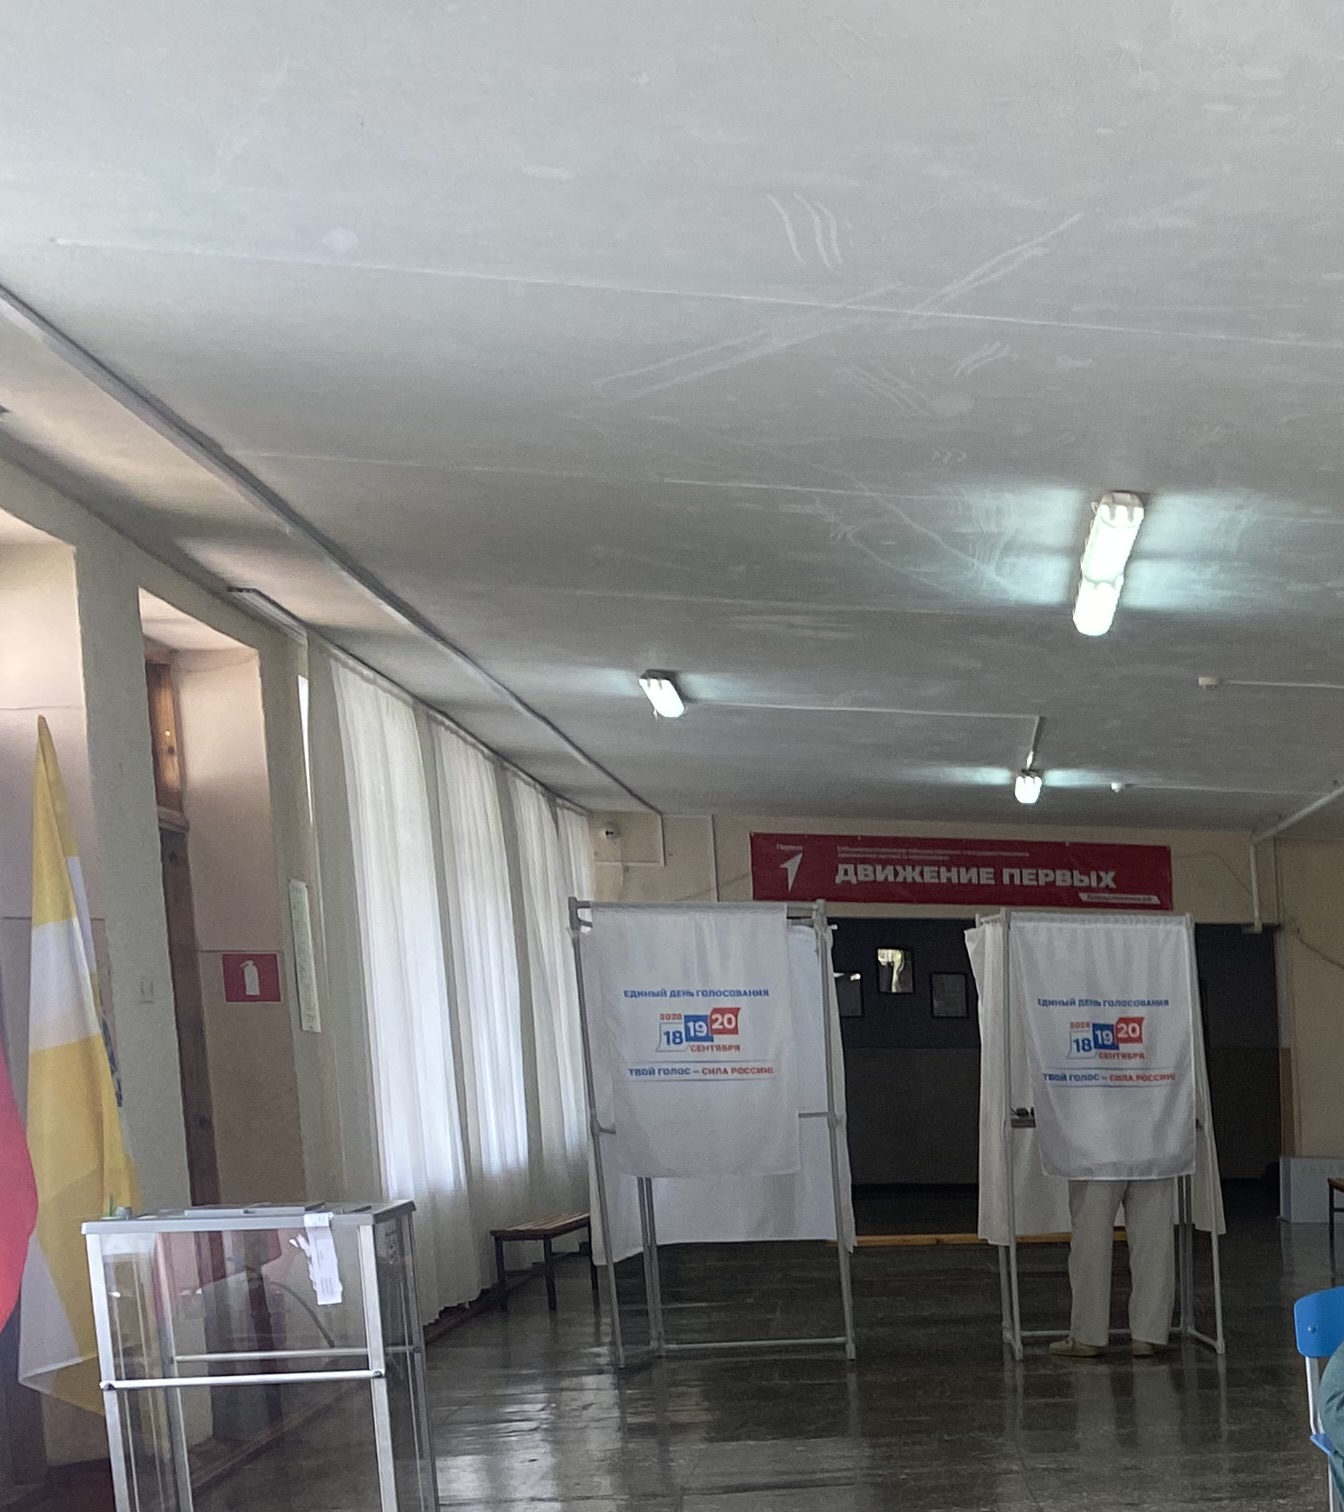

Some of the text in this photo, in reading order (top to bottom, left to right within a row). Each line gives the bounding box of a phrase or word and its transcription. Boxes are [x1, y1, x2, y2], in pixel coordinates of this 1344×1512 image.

[835, 863, 1117, 889] ДВИЖЕНИЕ ПЕРВЫХ
[624, 988, 769, 999] ЕДИНЫЙ ДЕНЬ ГОЛОСОВАНИЯ
[1103, 999, 1169, 1007] ГОЛОСОВАНИЯ
[664, 1013, 736, 1046] 18 19 20
[1073, 1023, 1140, 1053] 18 19 20
[690, 1044, 741, 1053] СЕНТЯБРЯ
[629, 1067, 656, 1077] ТВОЙ
[731, 1067, 774, 1075] РОССИИ!
[1043, 1073, 1068, 1081] ТВОЙ
[1069, 1073, 1099, 1082] ГОЛОС
[1109, 1073, 1133, 1081] СИЛА
